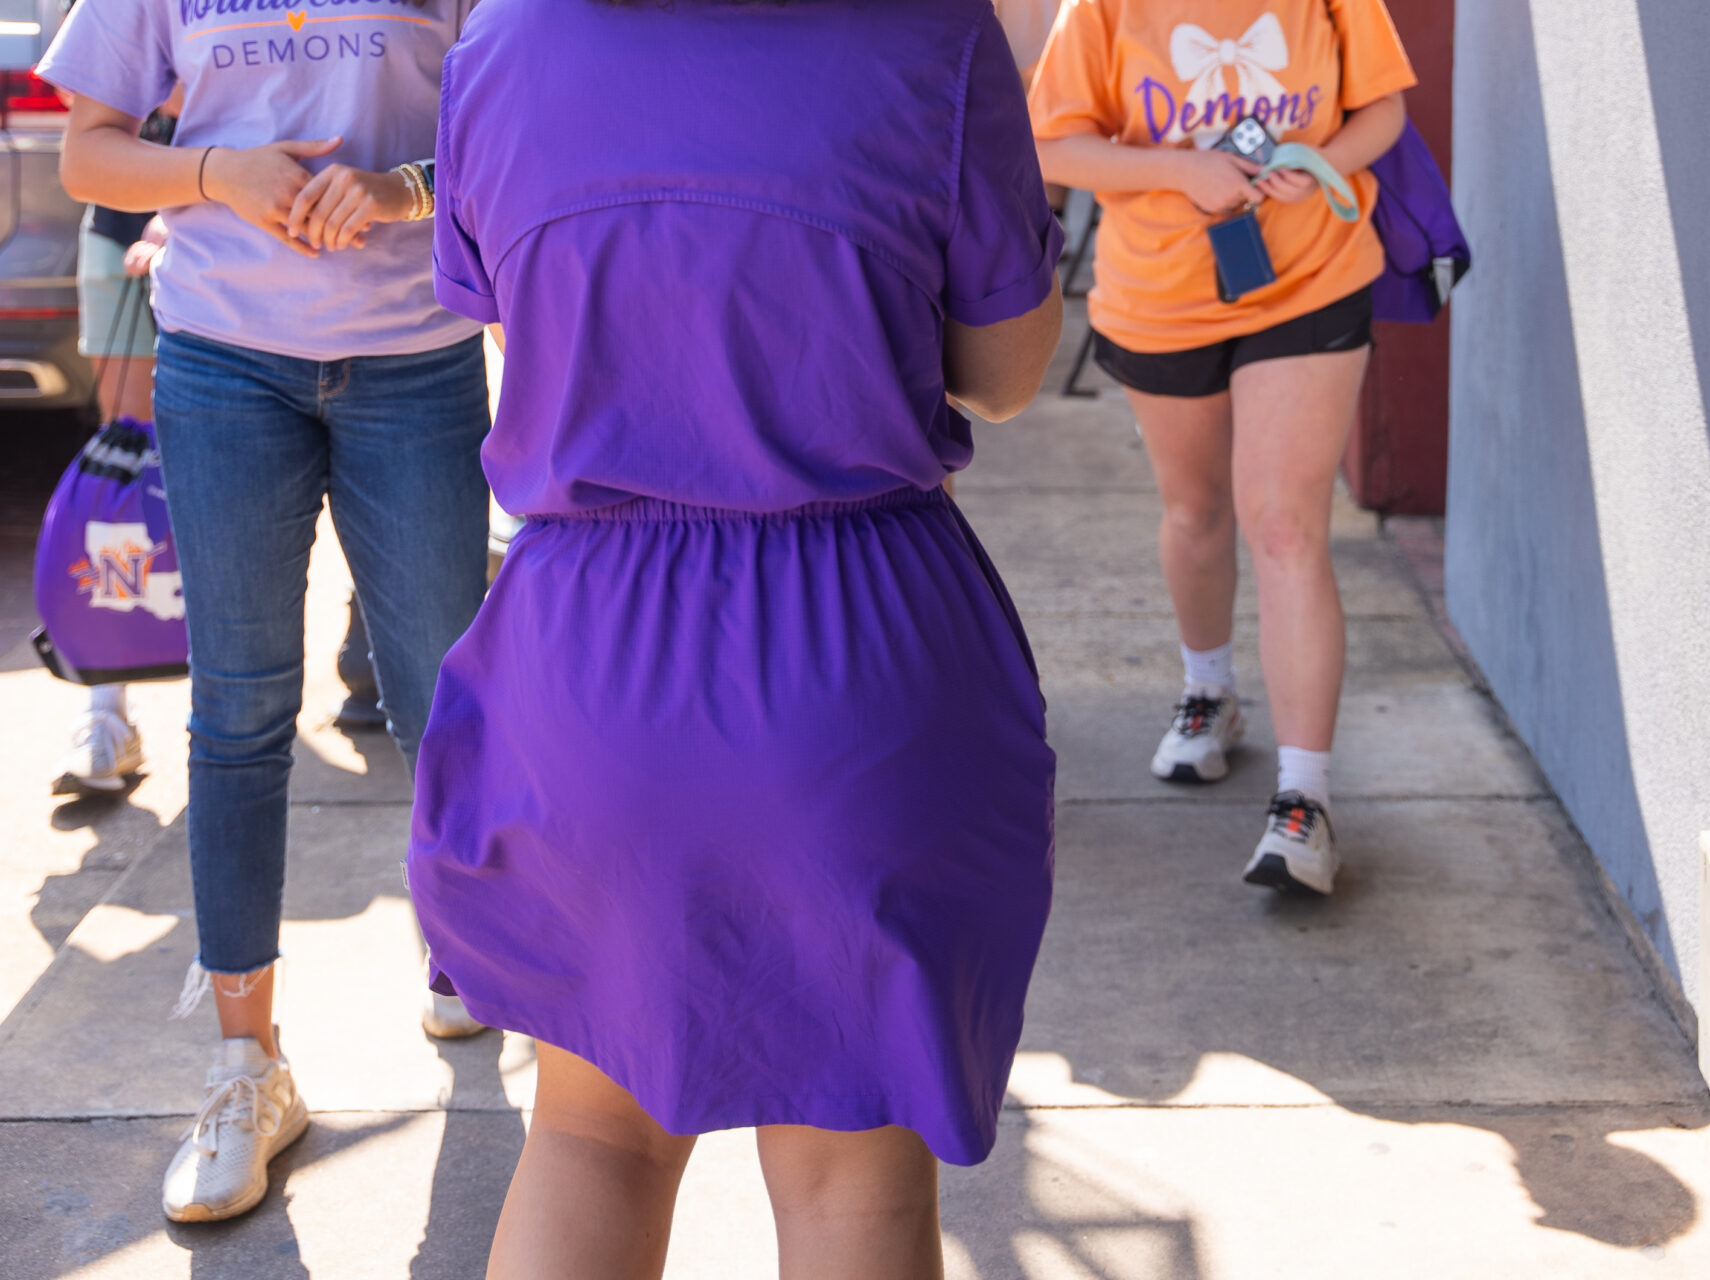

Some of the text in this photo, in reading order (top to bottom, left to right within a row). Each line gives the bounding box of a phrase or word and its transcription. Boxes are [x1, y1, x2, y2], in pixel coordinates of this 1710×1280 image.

[211, 31, 387, 70] DEMONS
[1134, 76, 1322, 144] Demons
[99, 553, 146, 599] N
